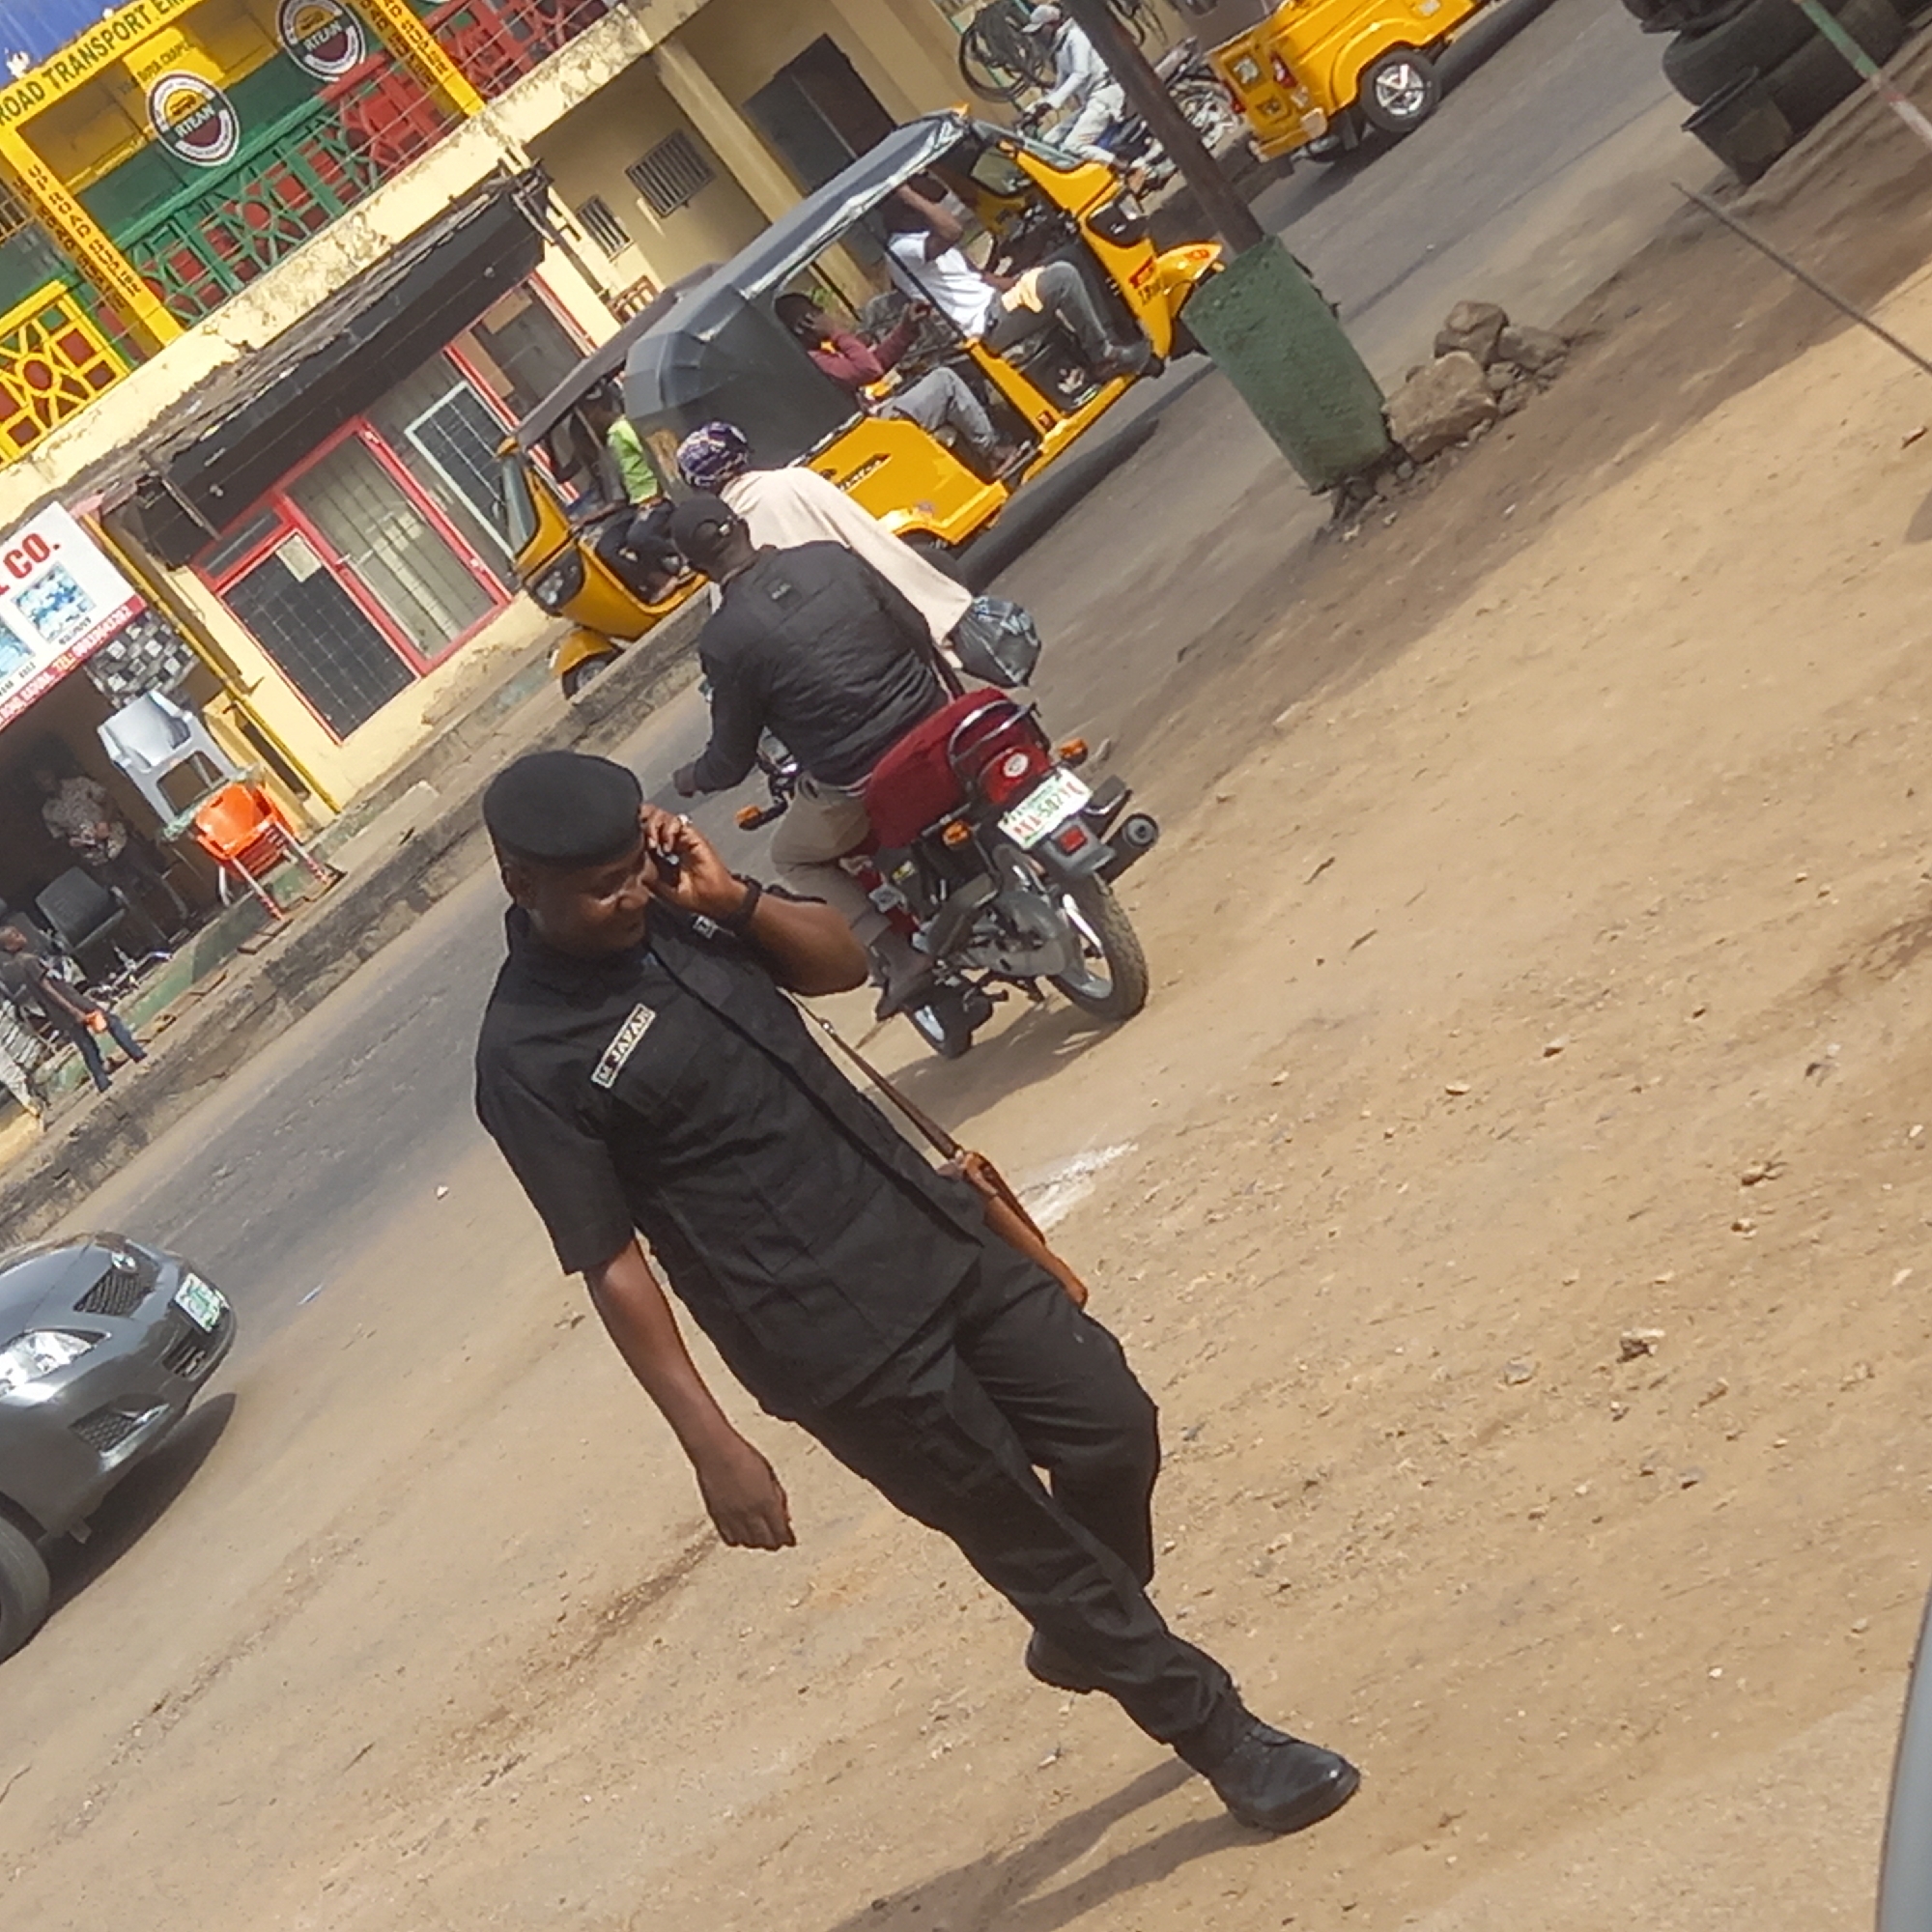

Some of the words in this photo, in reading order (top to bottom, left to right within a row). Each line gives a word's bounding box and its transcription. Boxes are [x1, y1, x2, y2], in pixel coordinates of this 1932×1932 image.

[42, 3, 152, 91] TRANSPORT
[174, 103, 216, 138] RTEAN
[47, 191, 92, 239] ROAD
[3, 532, 60, 580] CO.
